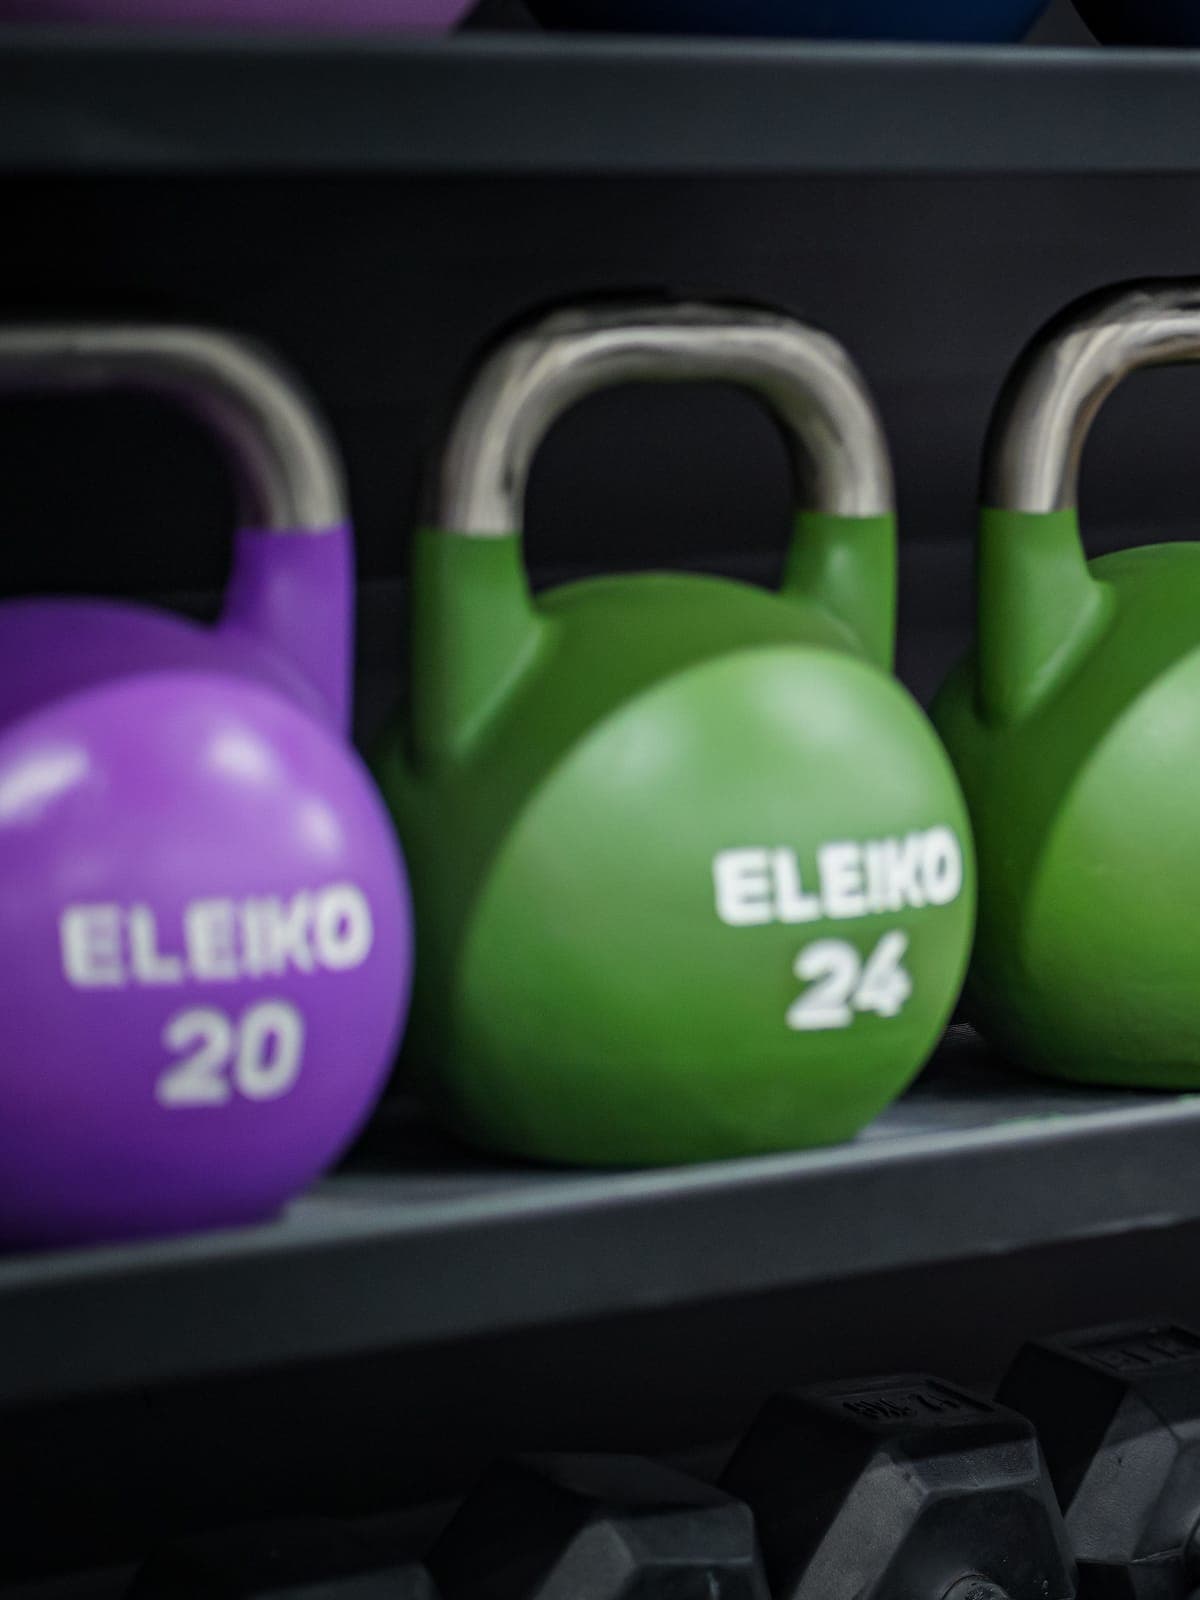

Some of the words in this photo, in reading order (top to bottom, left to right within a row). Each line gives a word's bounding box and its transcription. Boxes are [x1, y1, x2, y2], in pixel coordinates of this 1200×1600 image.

[713, 825, 963, 926] ELEIKO
[62, 883, 373, 988] ELEIKO
[785, 929, 912, 1030] 24
[155, 998, 305, 1108] 20
